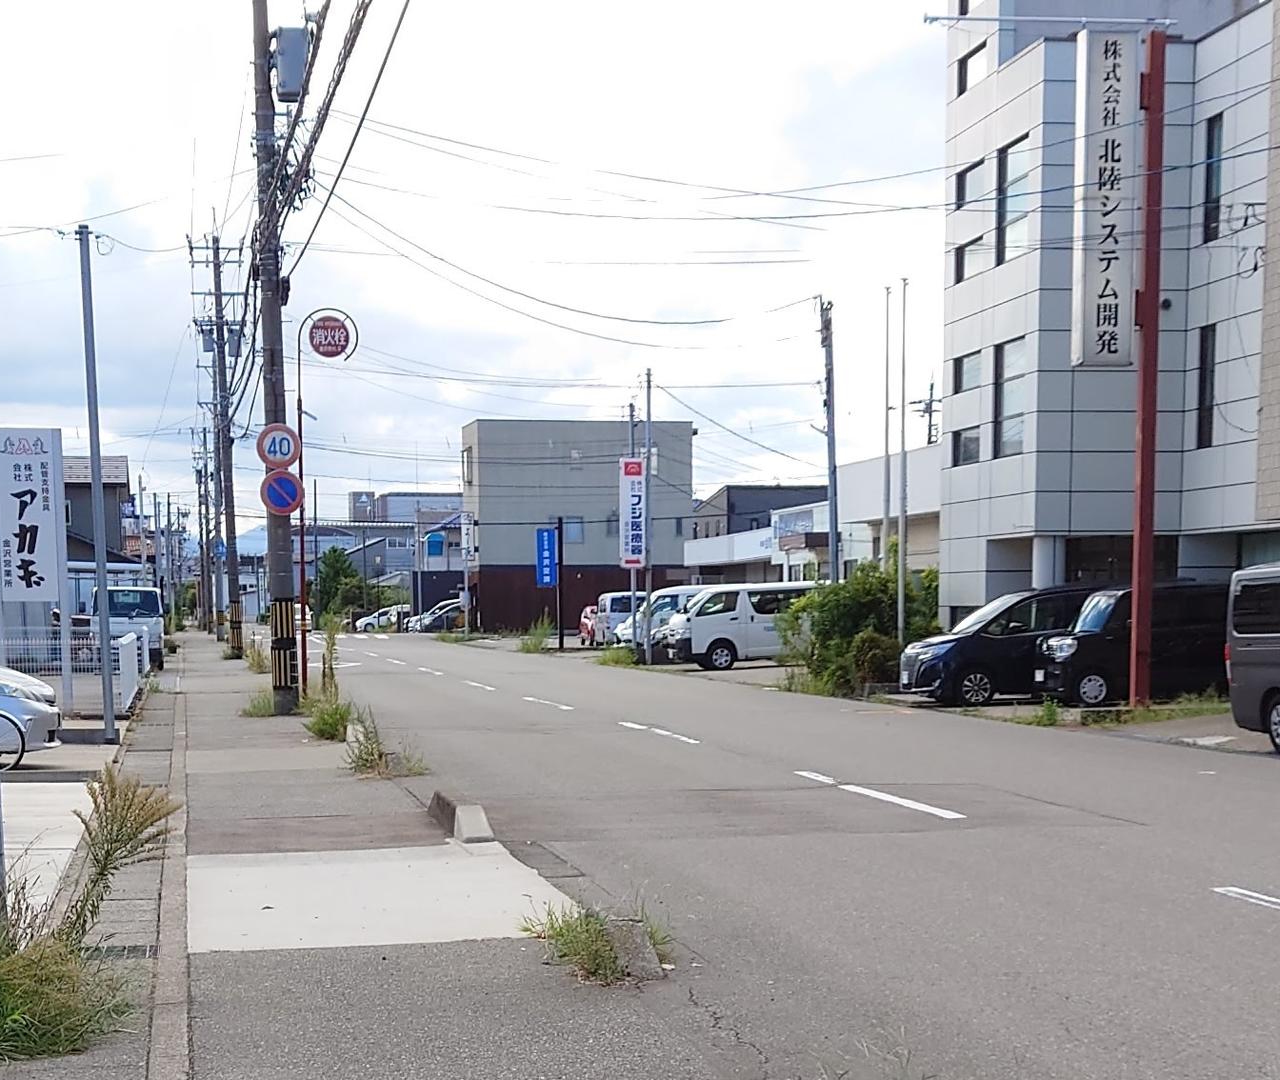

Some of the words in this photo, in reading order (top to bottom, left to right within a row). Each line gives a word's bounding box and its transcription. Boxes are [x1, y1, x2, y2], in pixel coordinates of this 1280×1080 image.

[1101, 39, 1123, 127] 株式会社
[1096, 139, 1123, 356] 北陸システム開発
[312, 328, 347, 345] 消火栓
[267, 436, 291, 457] 40
[2, 539, 13, 588] 金沢営業所
[10, 489, 45, 588] アカギ
